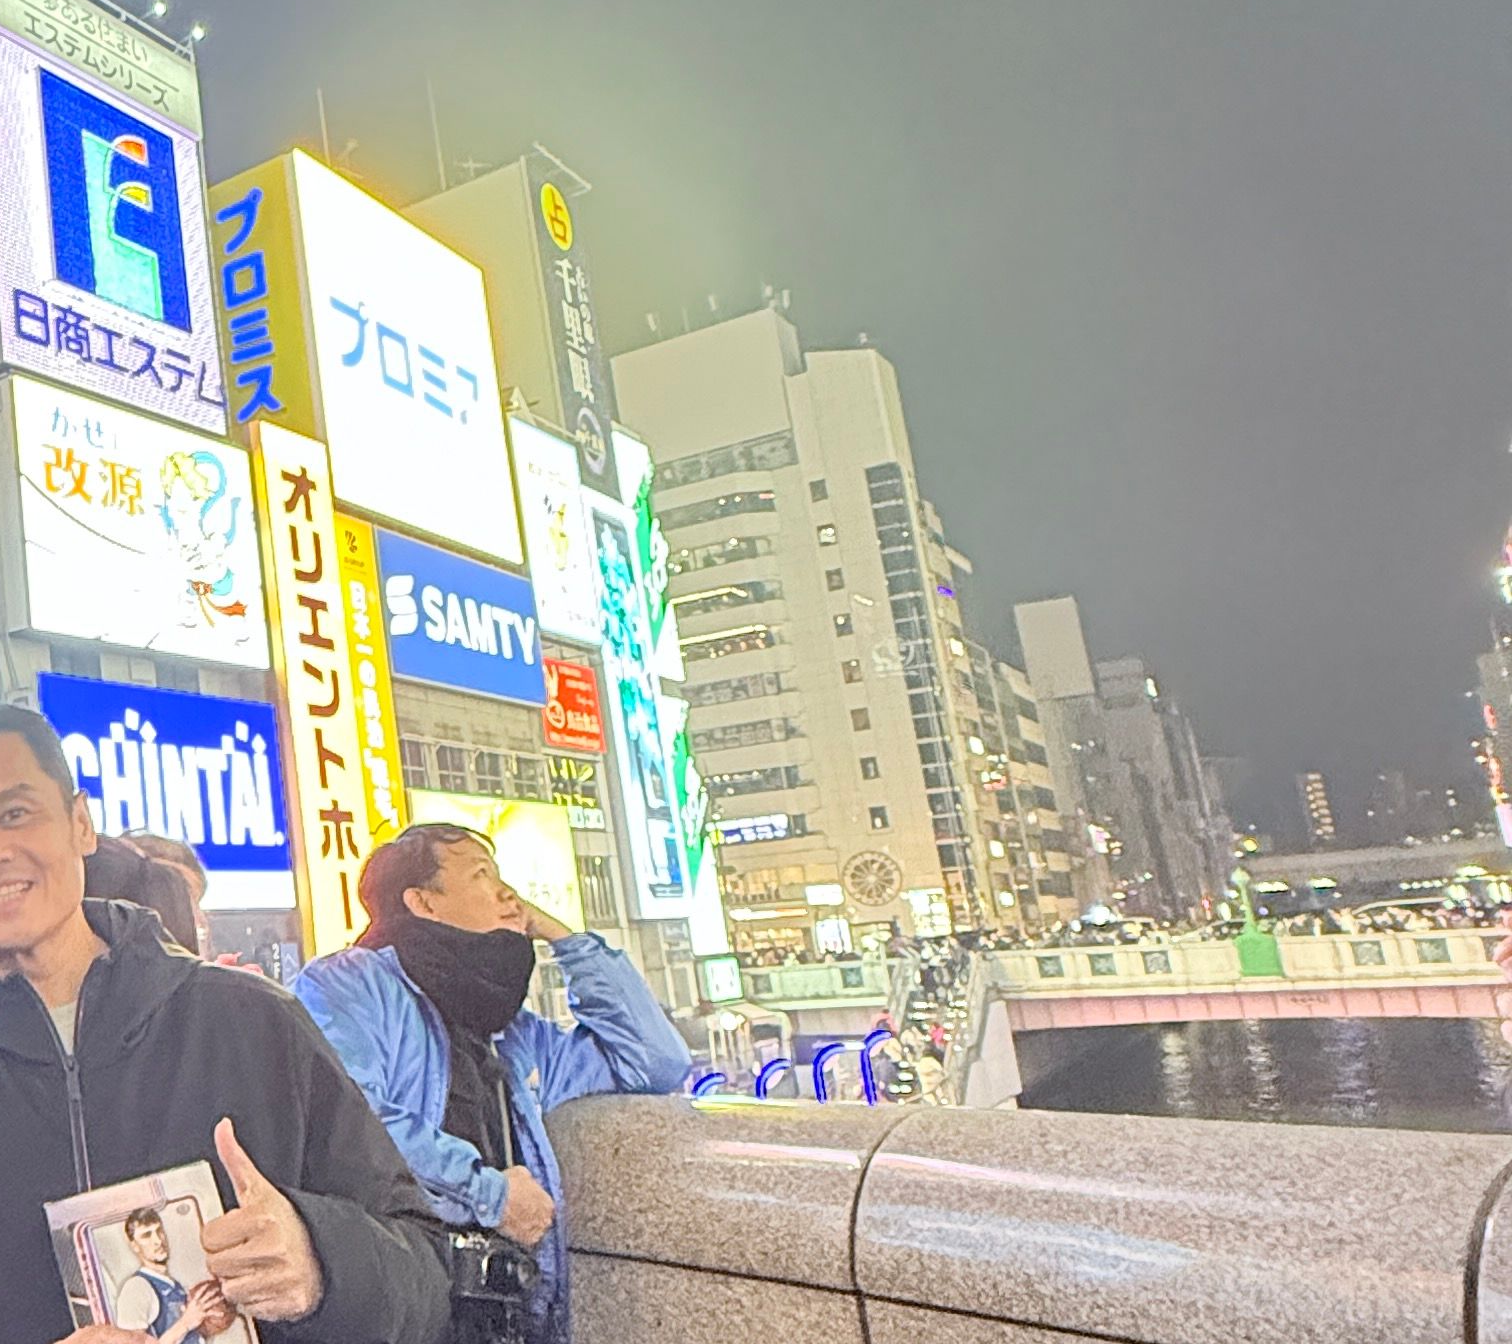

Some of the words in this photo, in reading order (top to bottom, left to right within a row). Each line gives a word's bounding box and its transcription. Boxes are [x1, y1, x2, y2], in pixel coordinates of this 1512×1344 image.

[215, 186, 284, 423] プロミス
[281, 466, 360, 931] オリエントホー
[421, 583, 536, 665] SAMTY
